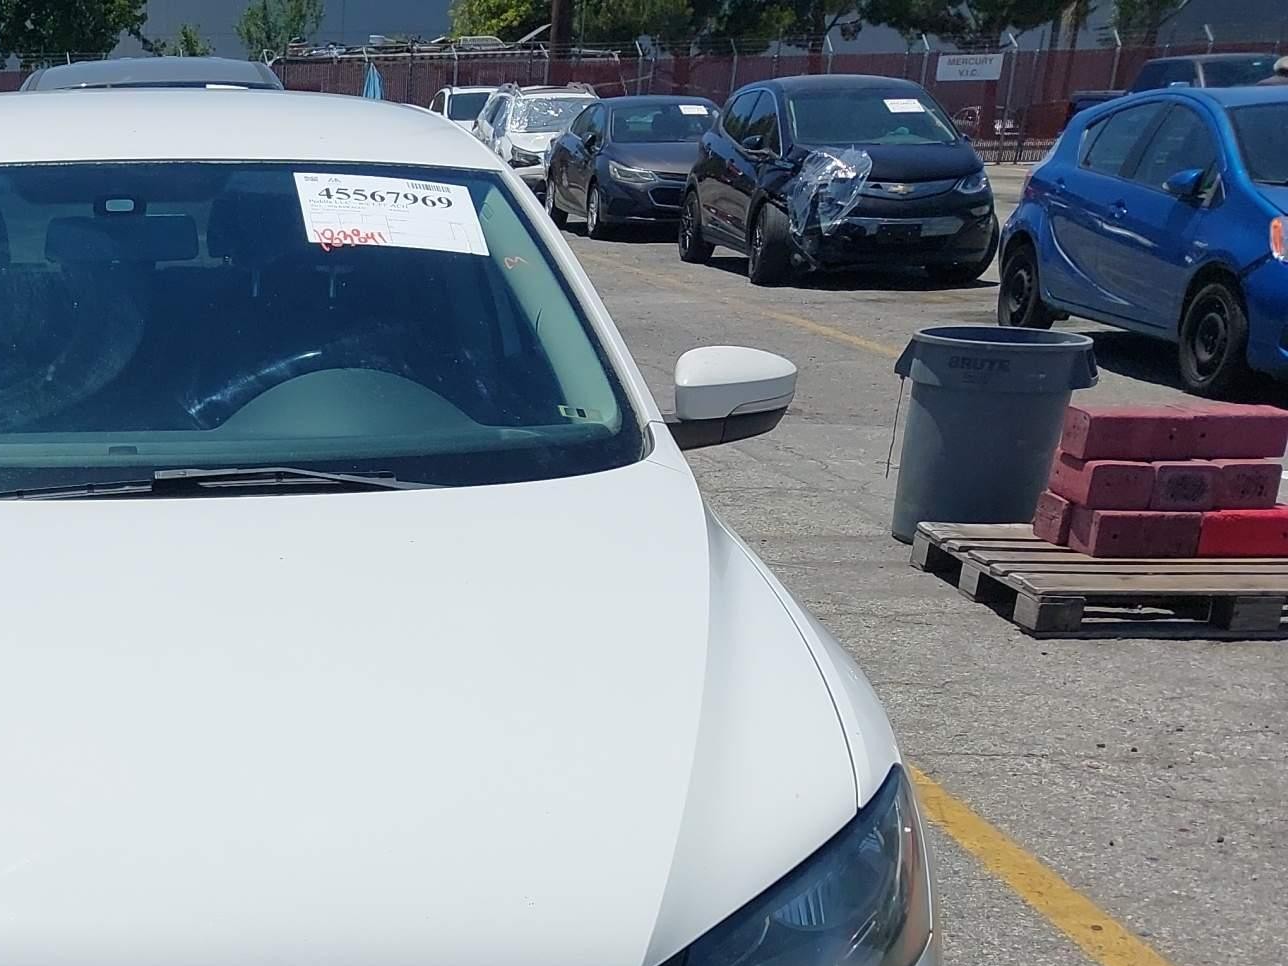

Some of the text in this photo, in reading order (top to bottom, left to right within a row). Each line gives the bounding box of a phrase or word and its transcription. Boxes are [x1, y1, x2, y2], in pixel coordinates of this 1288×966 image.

[947, 56, 994, 66] MERCURY
[318, 186, 453, 209] 45567969
[948, 355, 1011, 373] BRUTE
